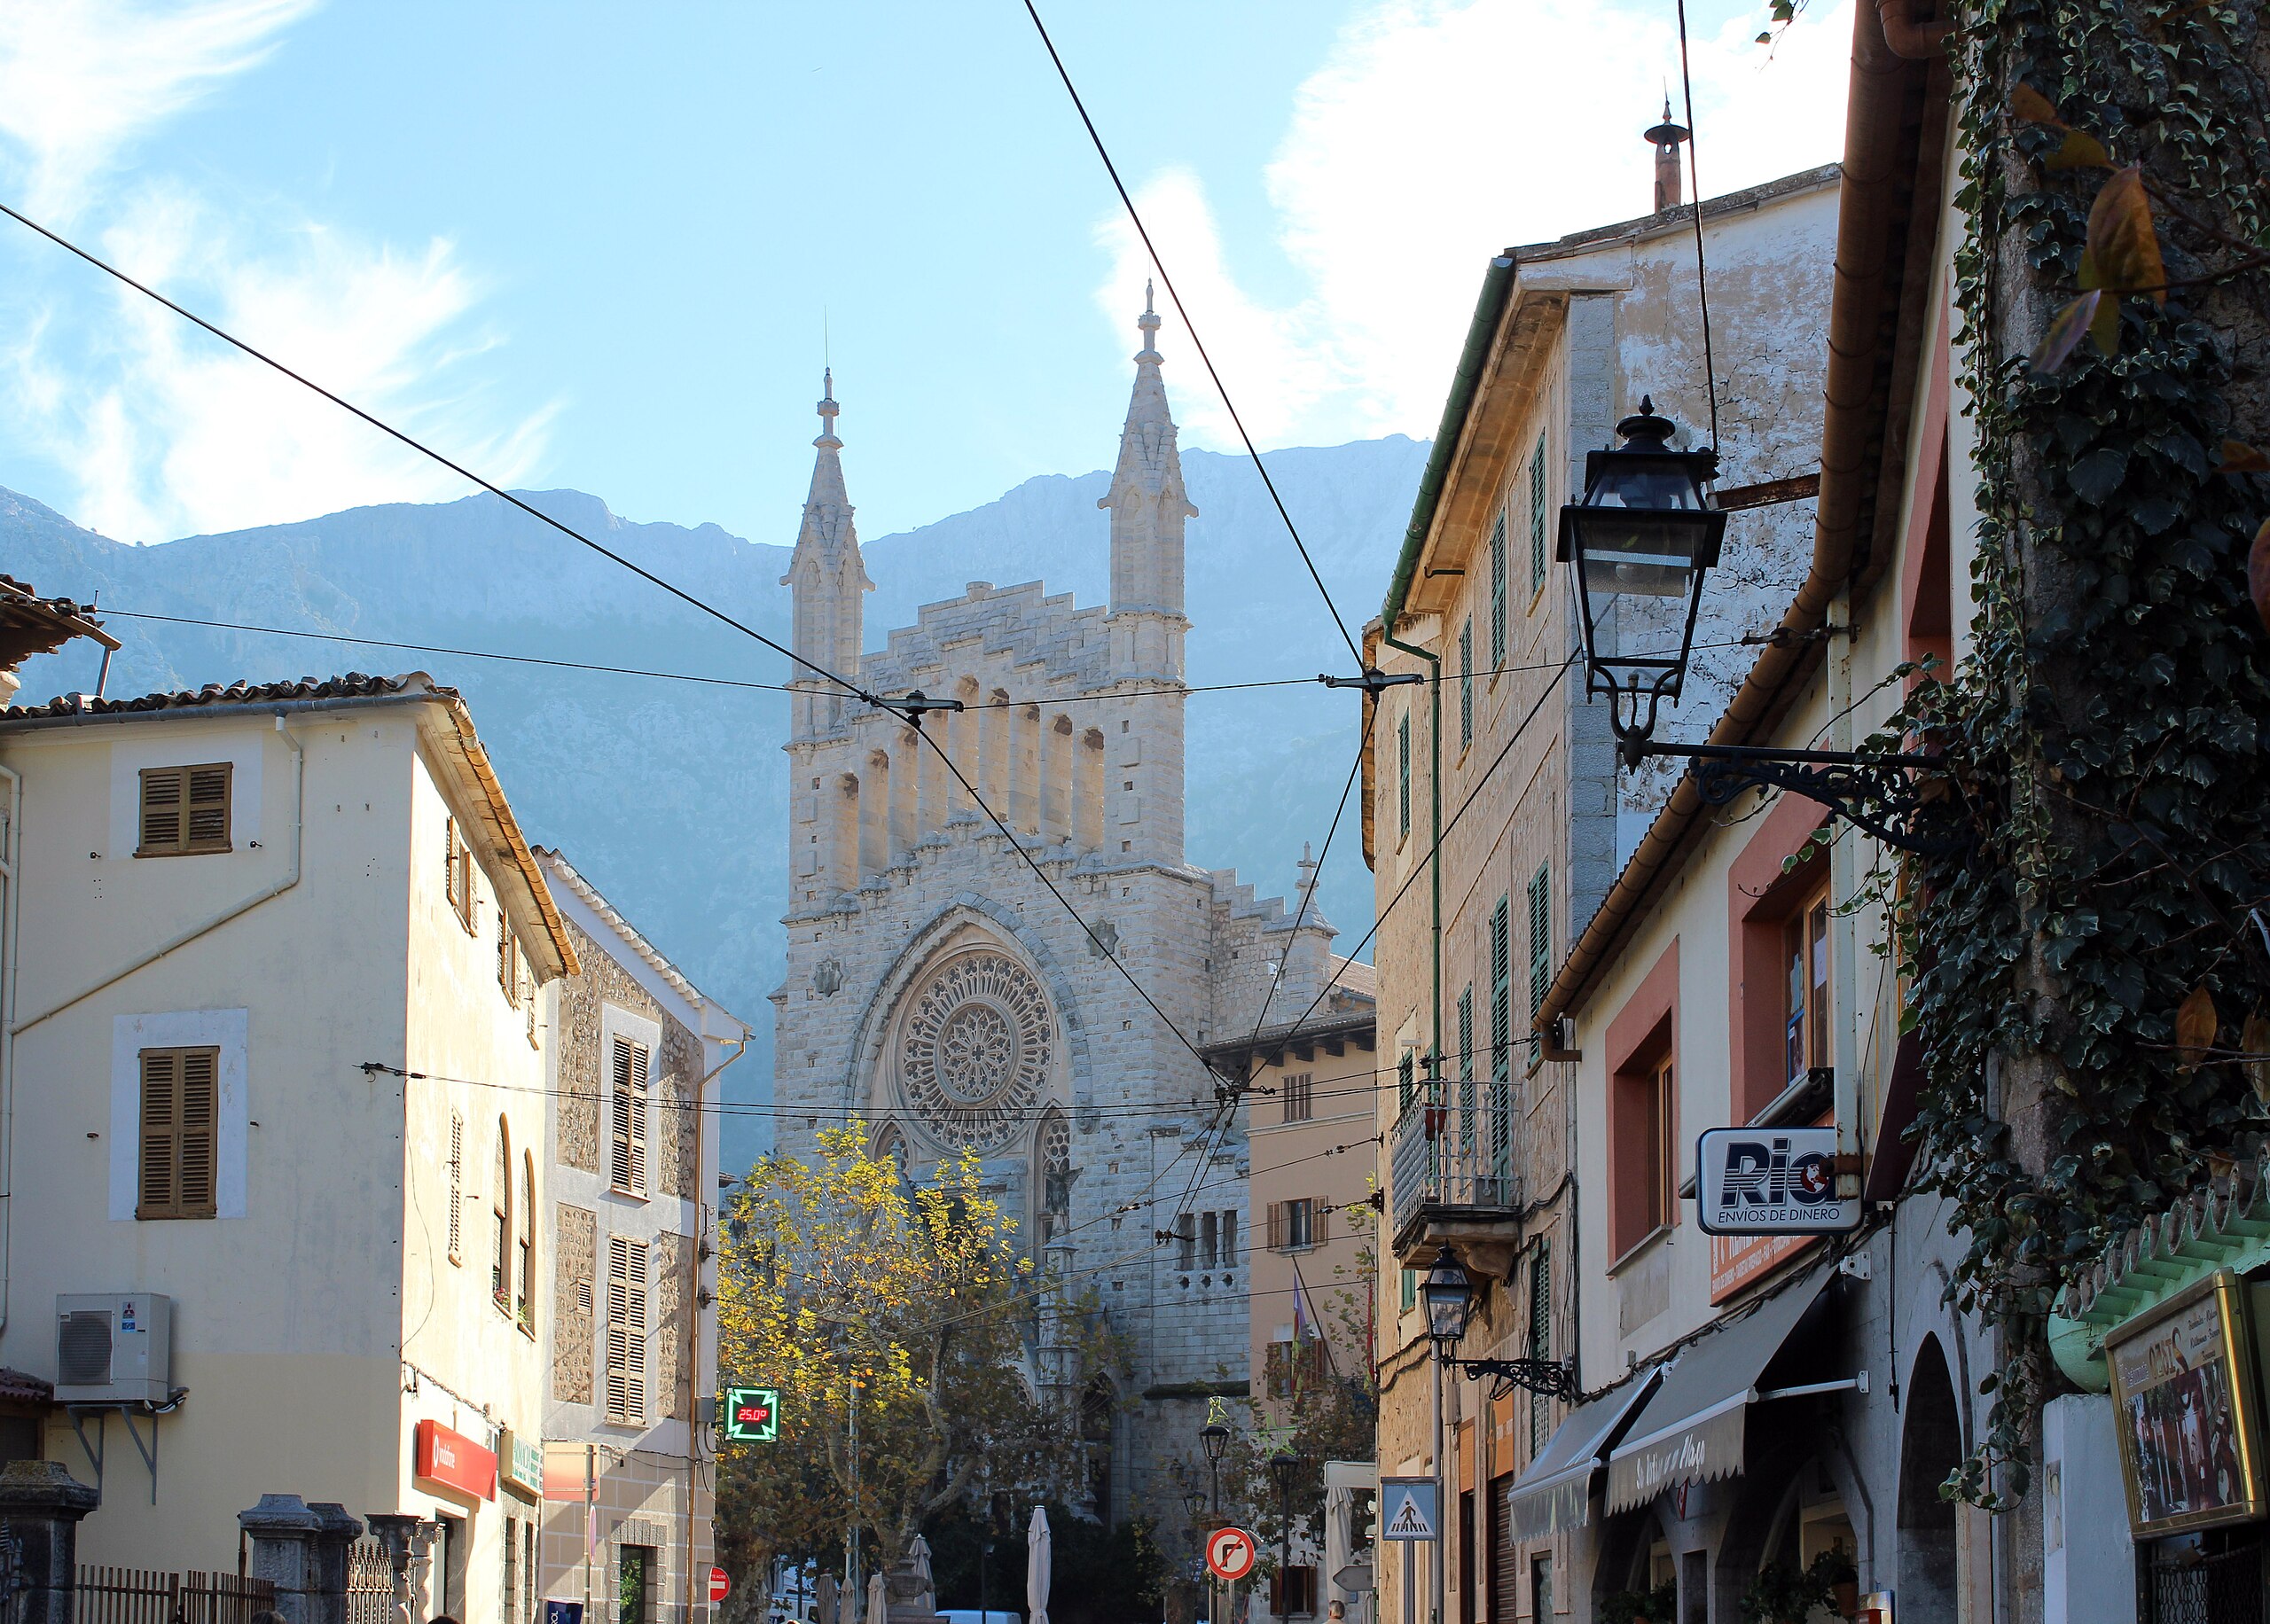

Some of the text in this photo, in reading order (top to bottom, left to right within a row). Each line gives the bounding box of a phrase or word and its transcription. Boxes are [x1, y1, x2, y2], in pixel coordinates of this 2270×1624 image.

[1718, 1206, 1841, 1223] ENVÍOS DE DINERO
